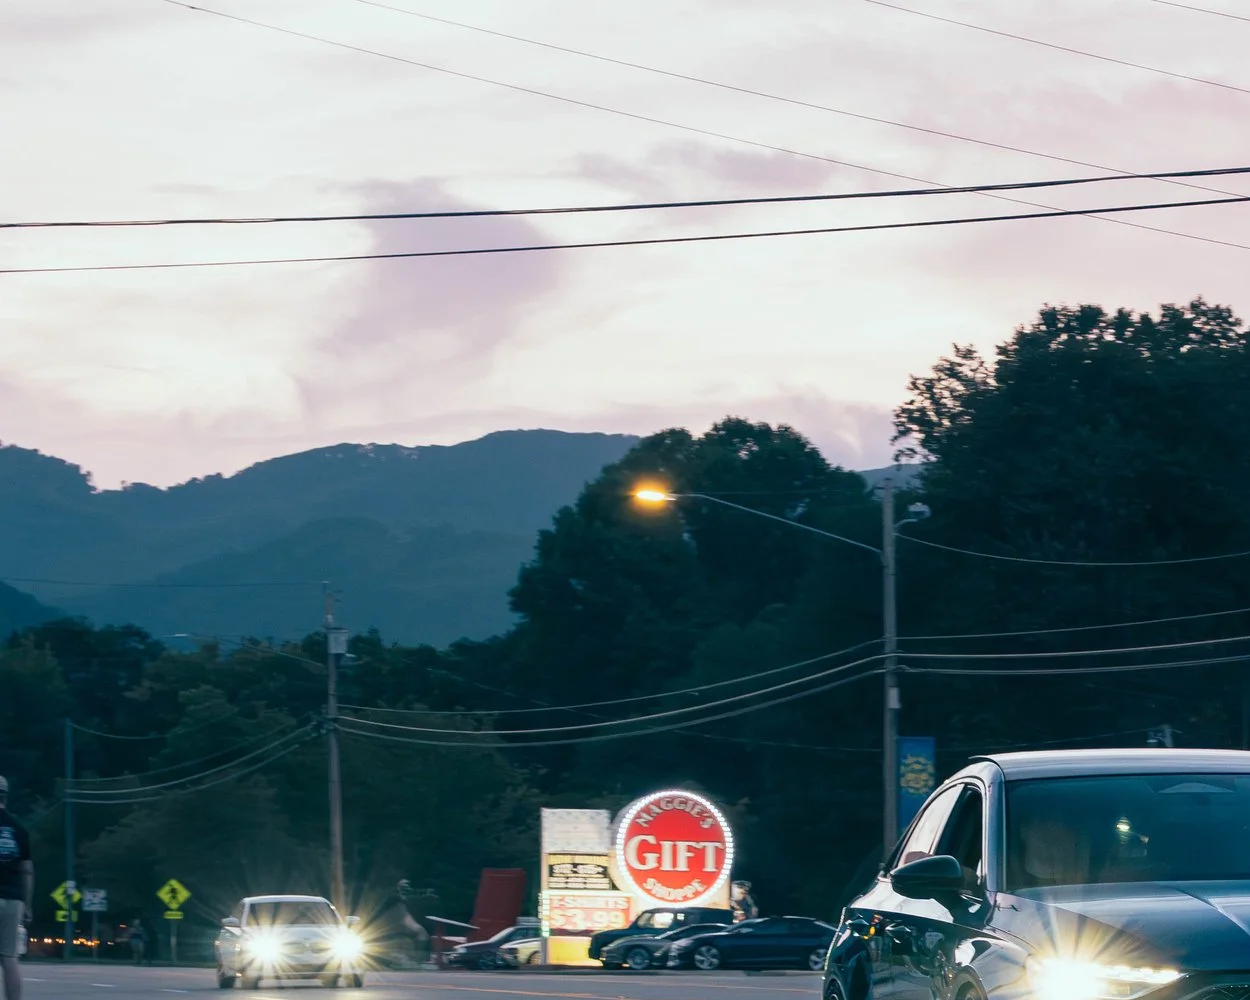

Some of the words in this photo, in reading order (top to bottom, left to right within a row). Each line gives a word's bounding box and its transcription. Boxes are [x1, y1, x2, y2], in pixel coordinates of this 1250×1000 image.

[634, 797, 716, 829] MAGGIE'S
[625, 834, 725, 872] GIFT
[642, 877, 707, 901] SHOPPE
